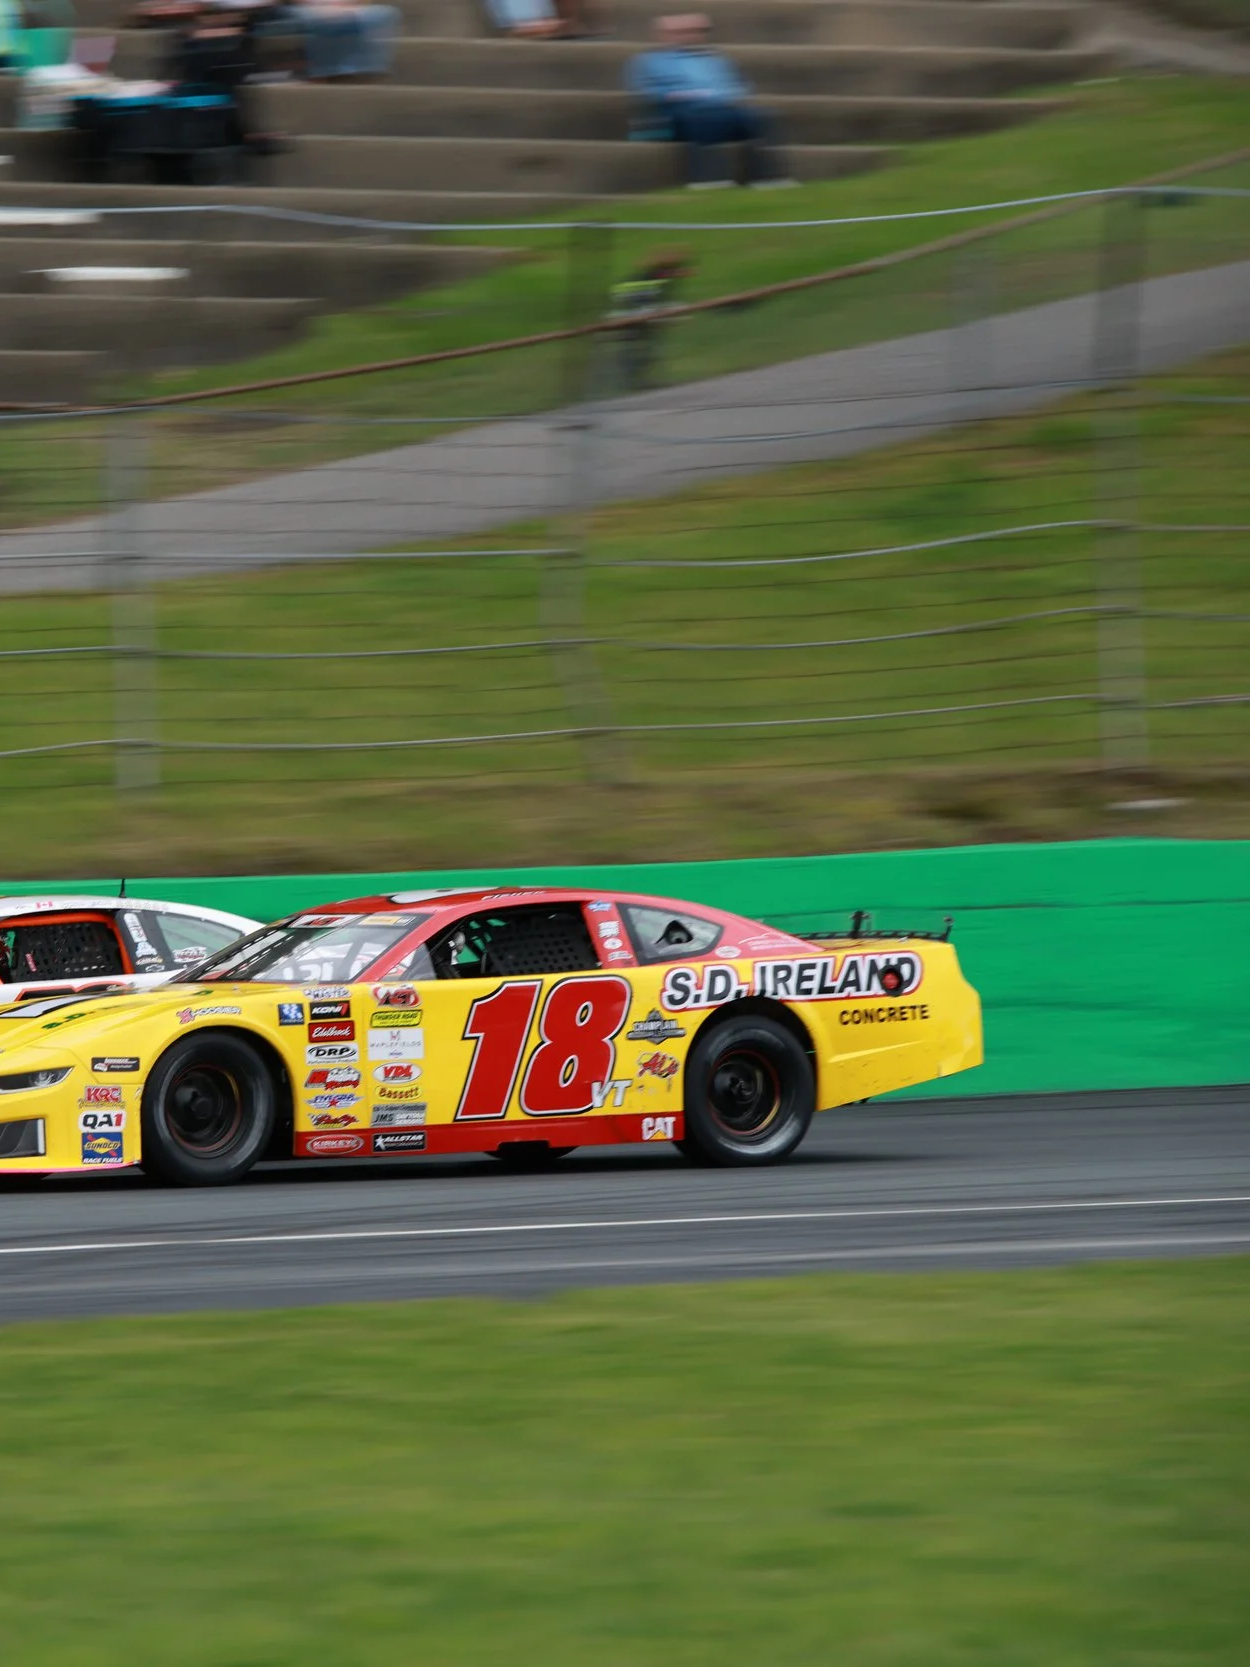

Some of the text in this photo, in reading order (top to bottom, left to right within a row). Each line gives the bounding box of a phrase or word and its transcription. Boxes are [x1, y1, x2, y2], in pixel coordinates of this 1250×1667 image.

[666, 955, 916, 1007] S.D. IRELAND
[311, 1005, 343, 1014] KONI
[839, 1004, 930, 1026] CONCRETE
[314, 1046, 350, 1057] DRP
[454, 974, 632, 1122] 18
[378, 1087, 419, 1100] Bassett
[591, 1079, 633, 1109] VT
[82, 1113, 123, 1129] QA1
[641, 1116, 677, 1141] CAT
[85, 1142, 119, 1150] SUNOCO
